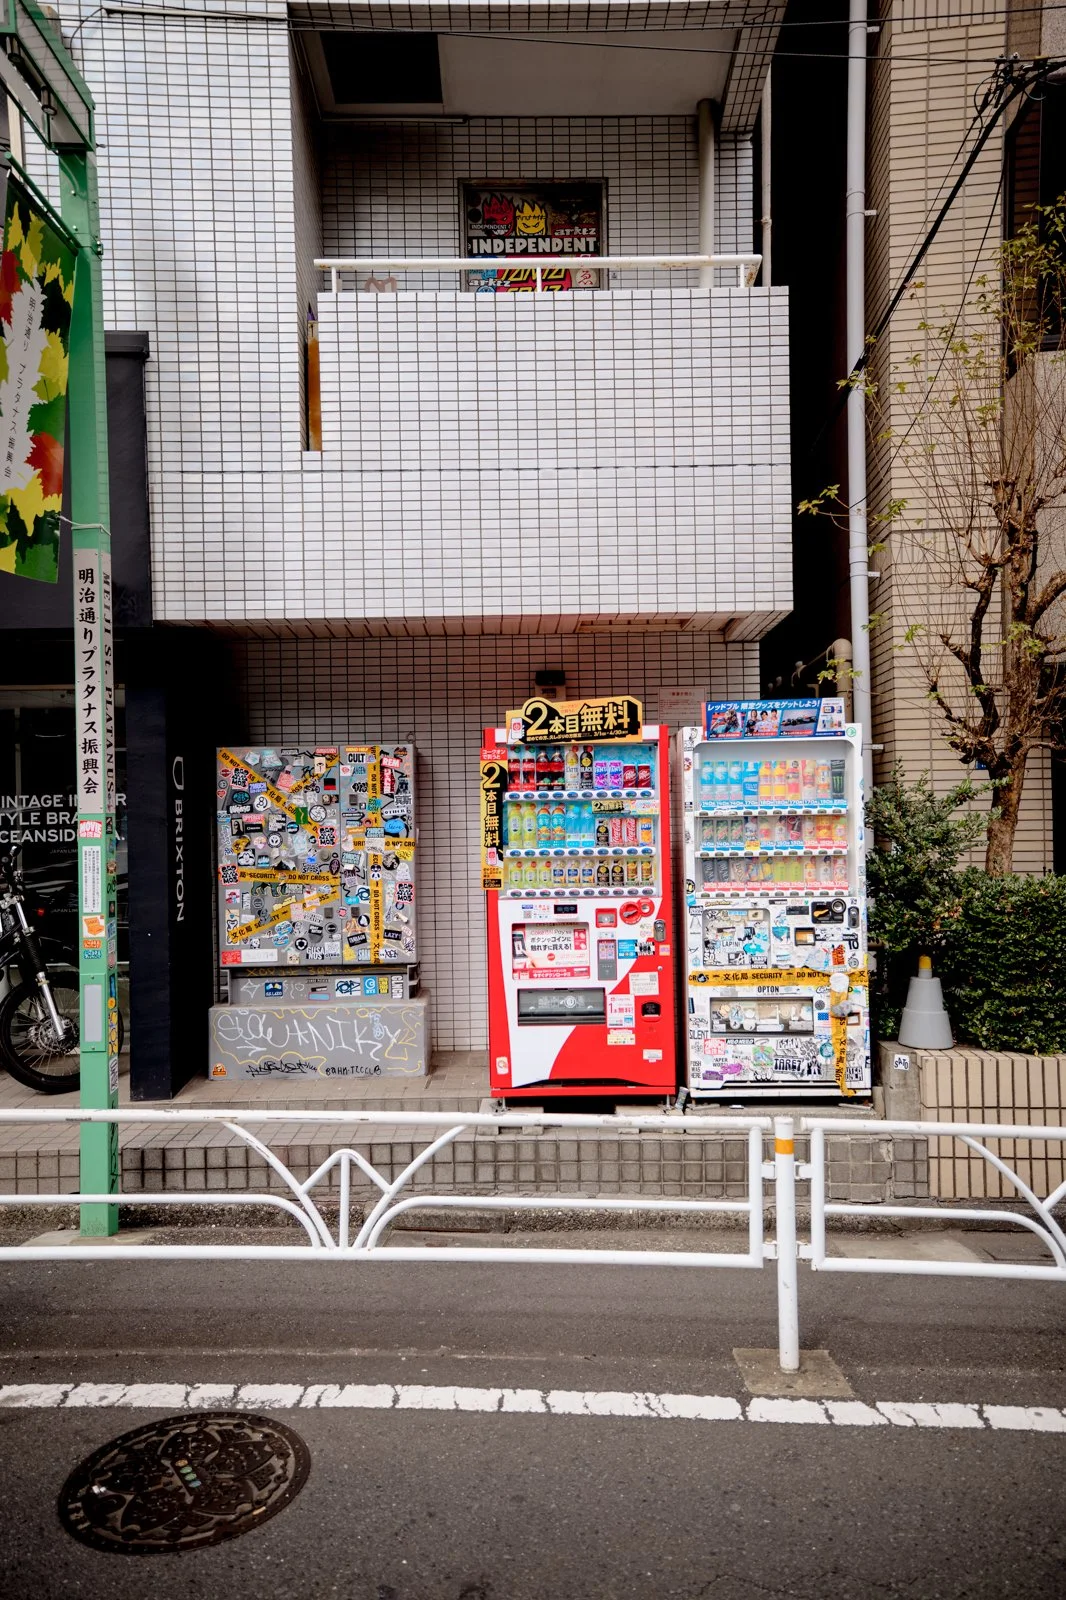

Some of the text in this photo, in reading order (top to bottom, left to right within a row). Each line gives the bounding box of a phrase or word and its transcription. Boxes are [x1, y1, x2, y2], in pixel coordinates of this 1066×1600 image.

[472, 237, 597, 254] INDEPENDENT
[103, 572, 112, 635] MEIJI
[78, 567, 100, 795] 明治通りプラタナス振興会
[525, 701, 632, 737] 2本目無料
[105, 685, 115, 799] PLATANUS
[348, 753, 366, 763] CULT
[0, 794, 64, 808] INTAGE
[481, 761, 501, 847] 2本目無料
[0, 811, 79, 826] TYLE BRA
[0, 829, 78, 843] CEANSID
[174, 799, 185, 922] BRIXTON
[751, 972, 783, 980] SECURITY
[757, 985, 780, 993] OPTON
[894, 1057, 909, 1070] SATO
